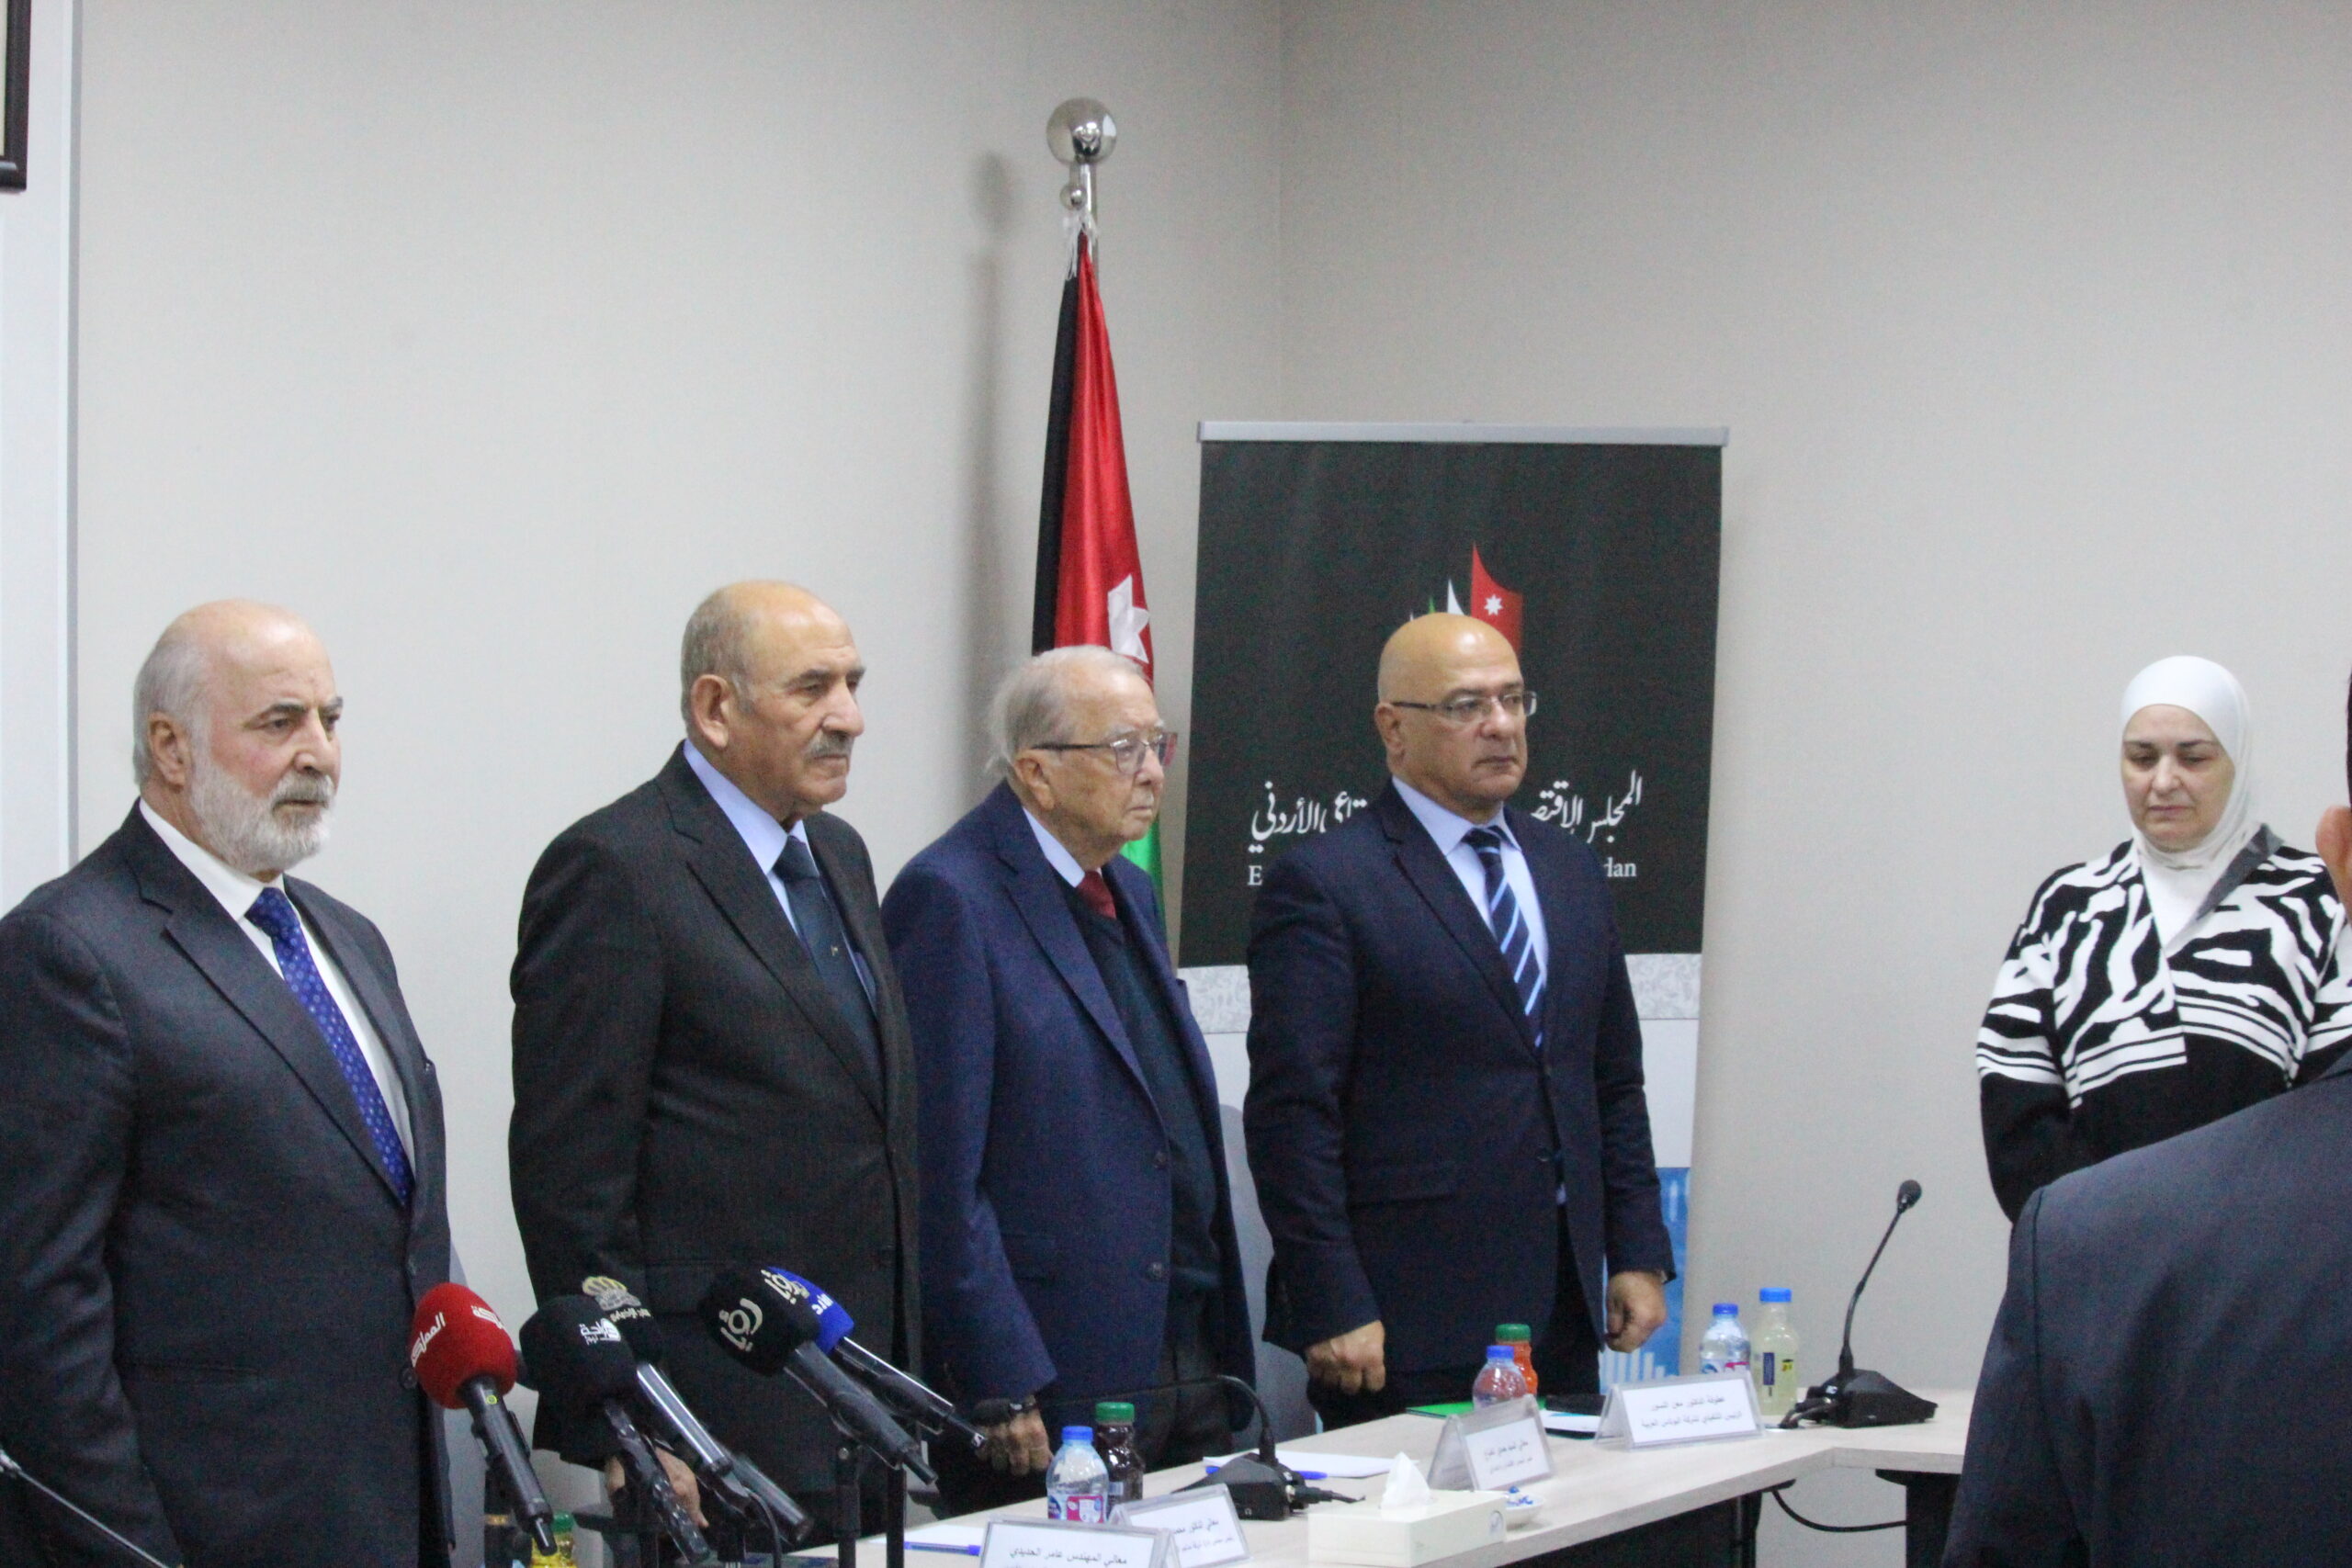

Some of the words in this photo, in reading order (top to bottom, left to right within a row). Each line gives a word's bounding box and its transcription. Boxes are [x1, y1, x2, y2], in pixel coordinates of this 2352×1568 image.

[1248, 780, 1320, 853] الأردني
[1586, 770, 1643, 844] المجلس
[718, 1297, 763, 1352] رؤيا
[1066, 1551, 1102, 1563] المهندس
[1103, 1553, 1126, 1567] معالي
